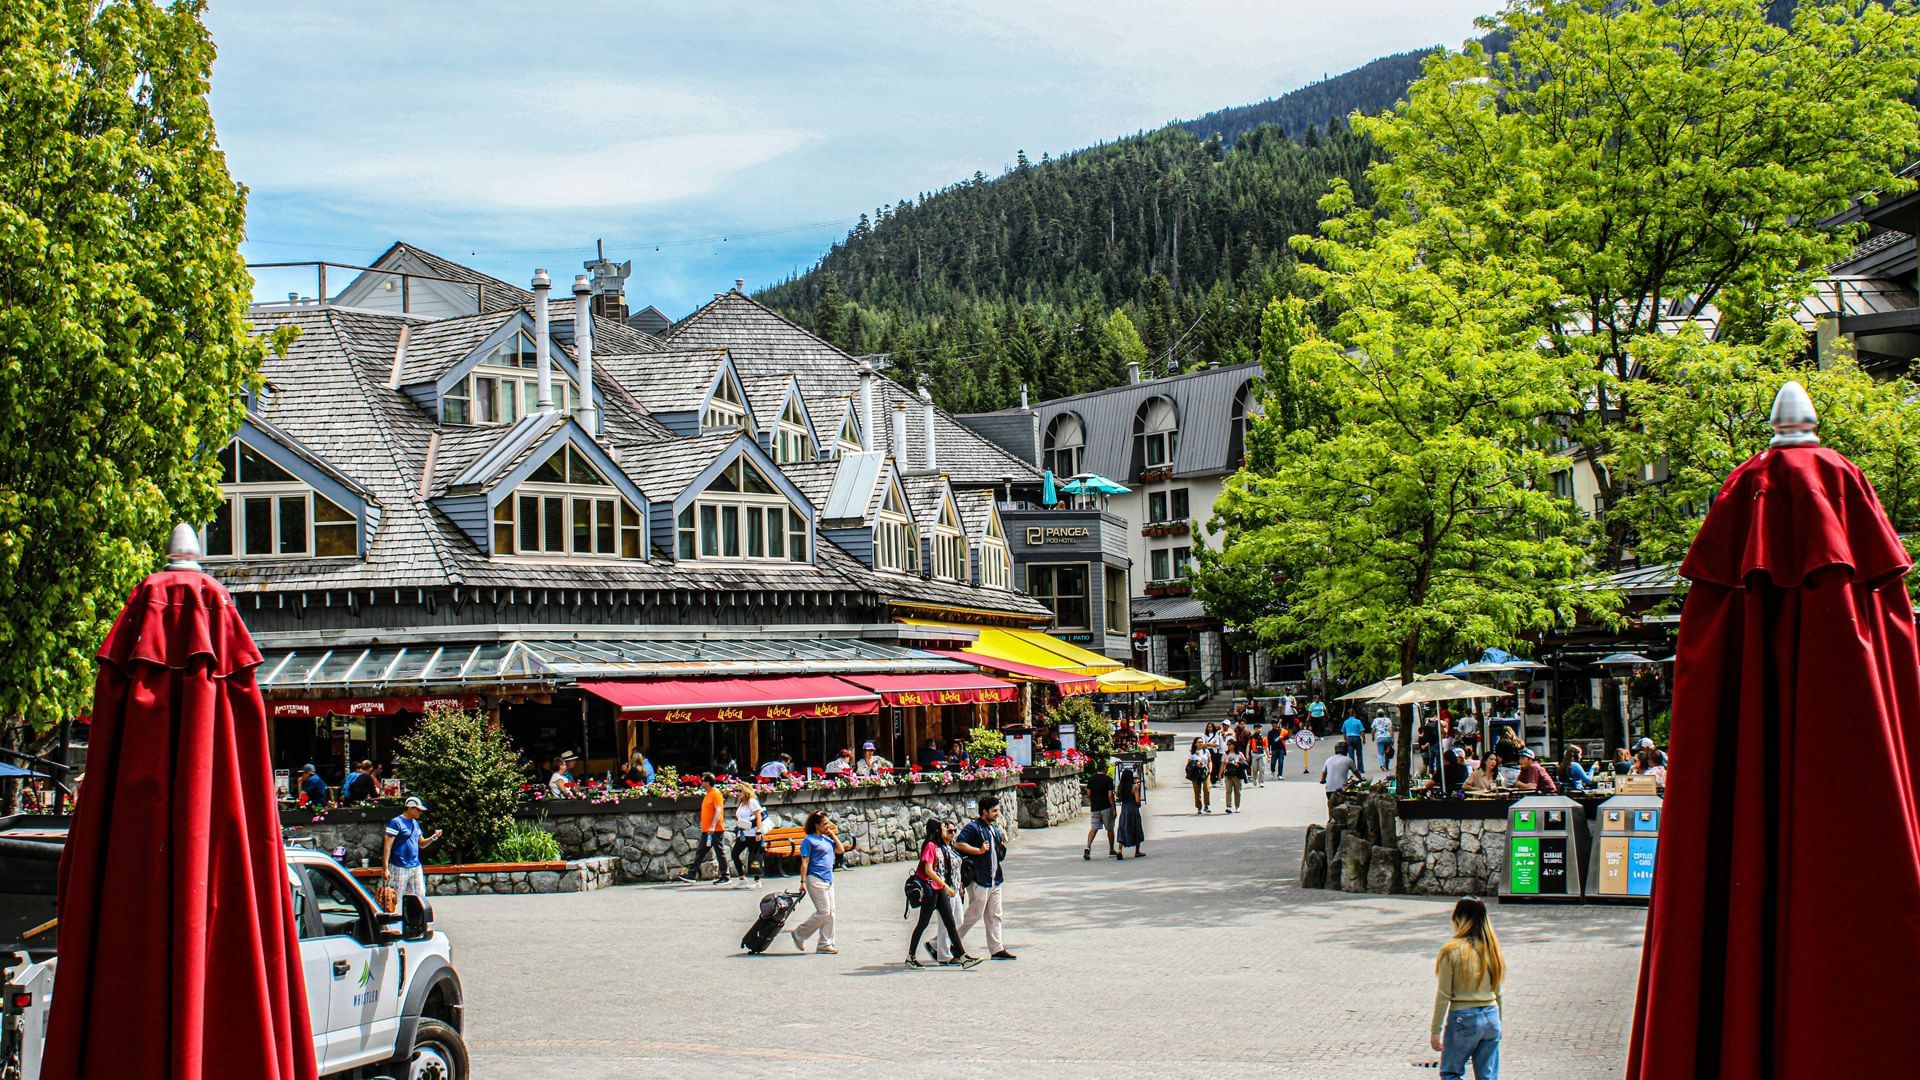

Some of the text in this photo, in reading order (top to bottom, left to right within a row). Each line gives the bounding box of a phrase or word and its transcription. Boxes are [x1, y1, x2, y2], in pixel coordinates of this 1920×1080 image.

[1046, 527, 1090, 537] PANGEA
[274, 704, 310, 715] AMSTERDAM
[350, 702, 385, 714] AMSTERDAM
[353, 990, 378, 1007] WHISTLER
